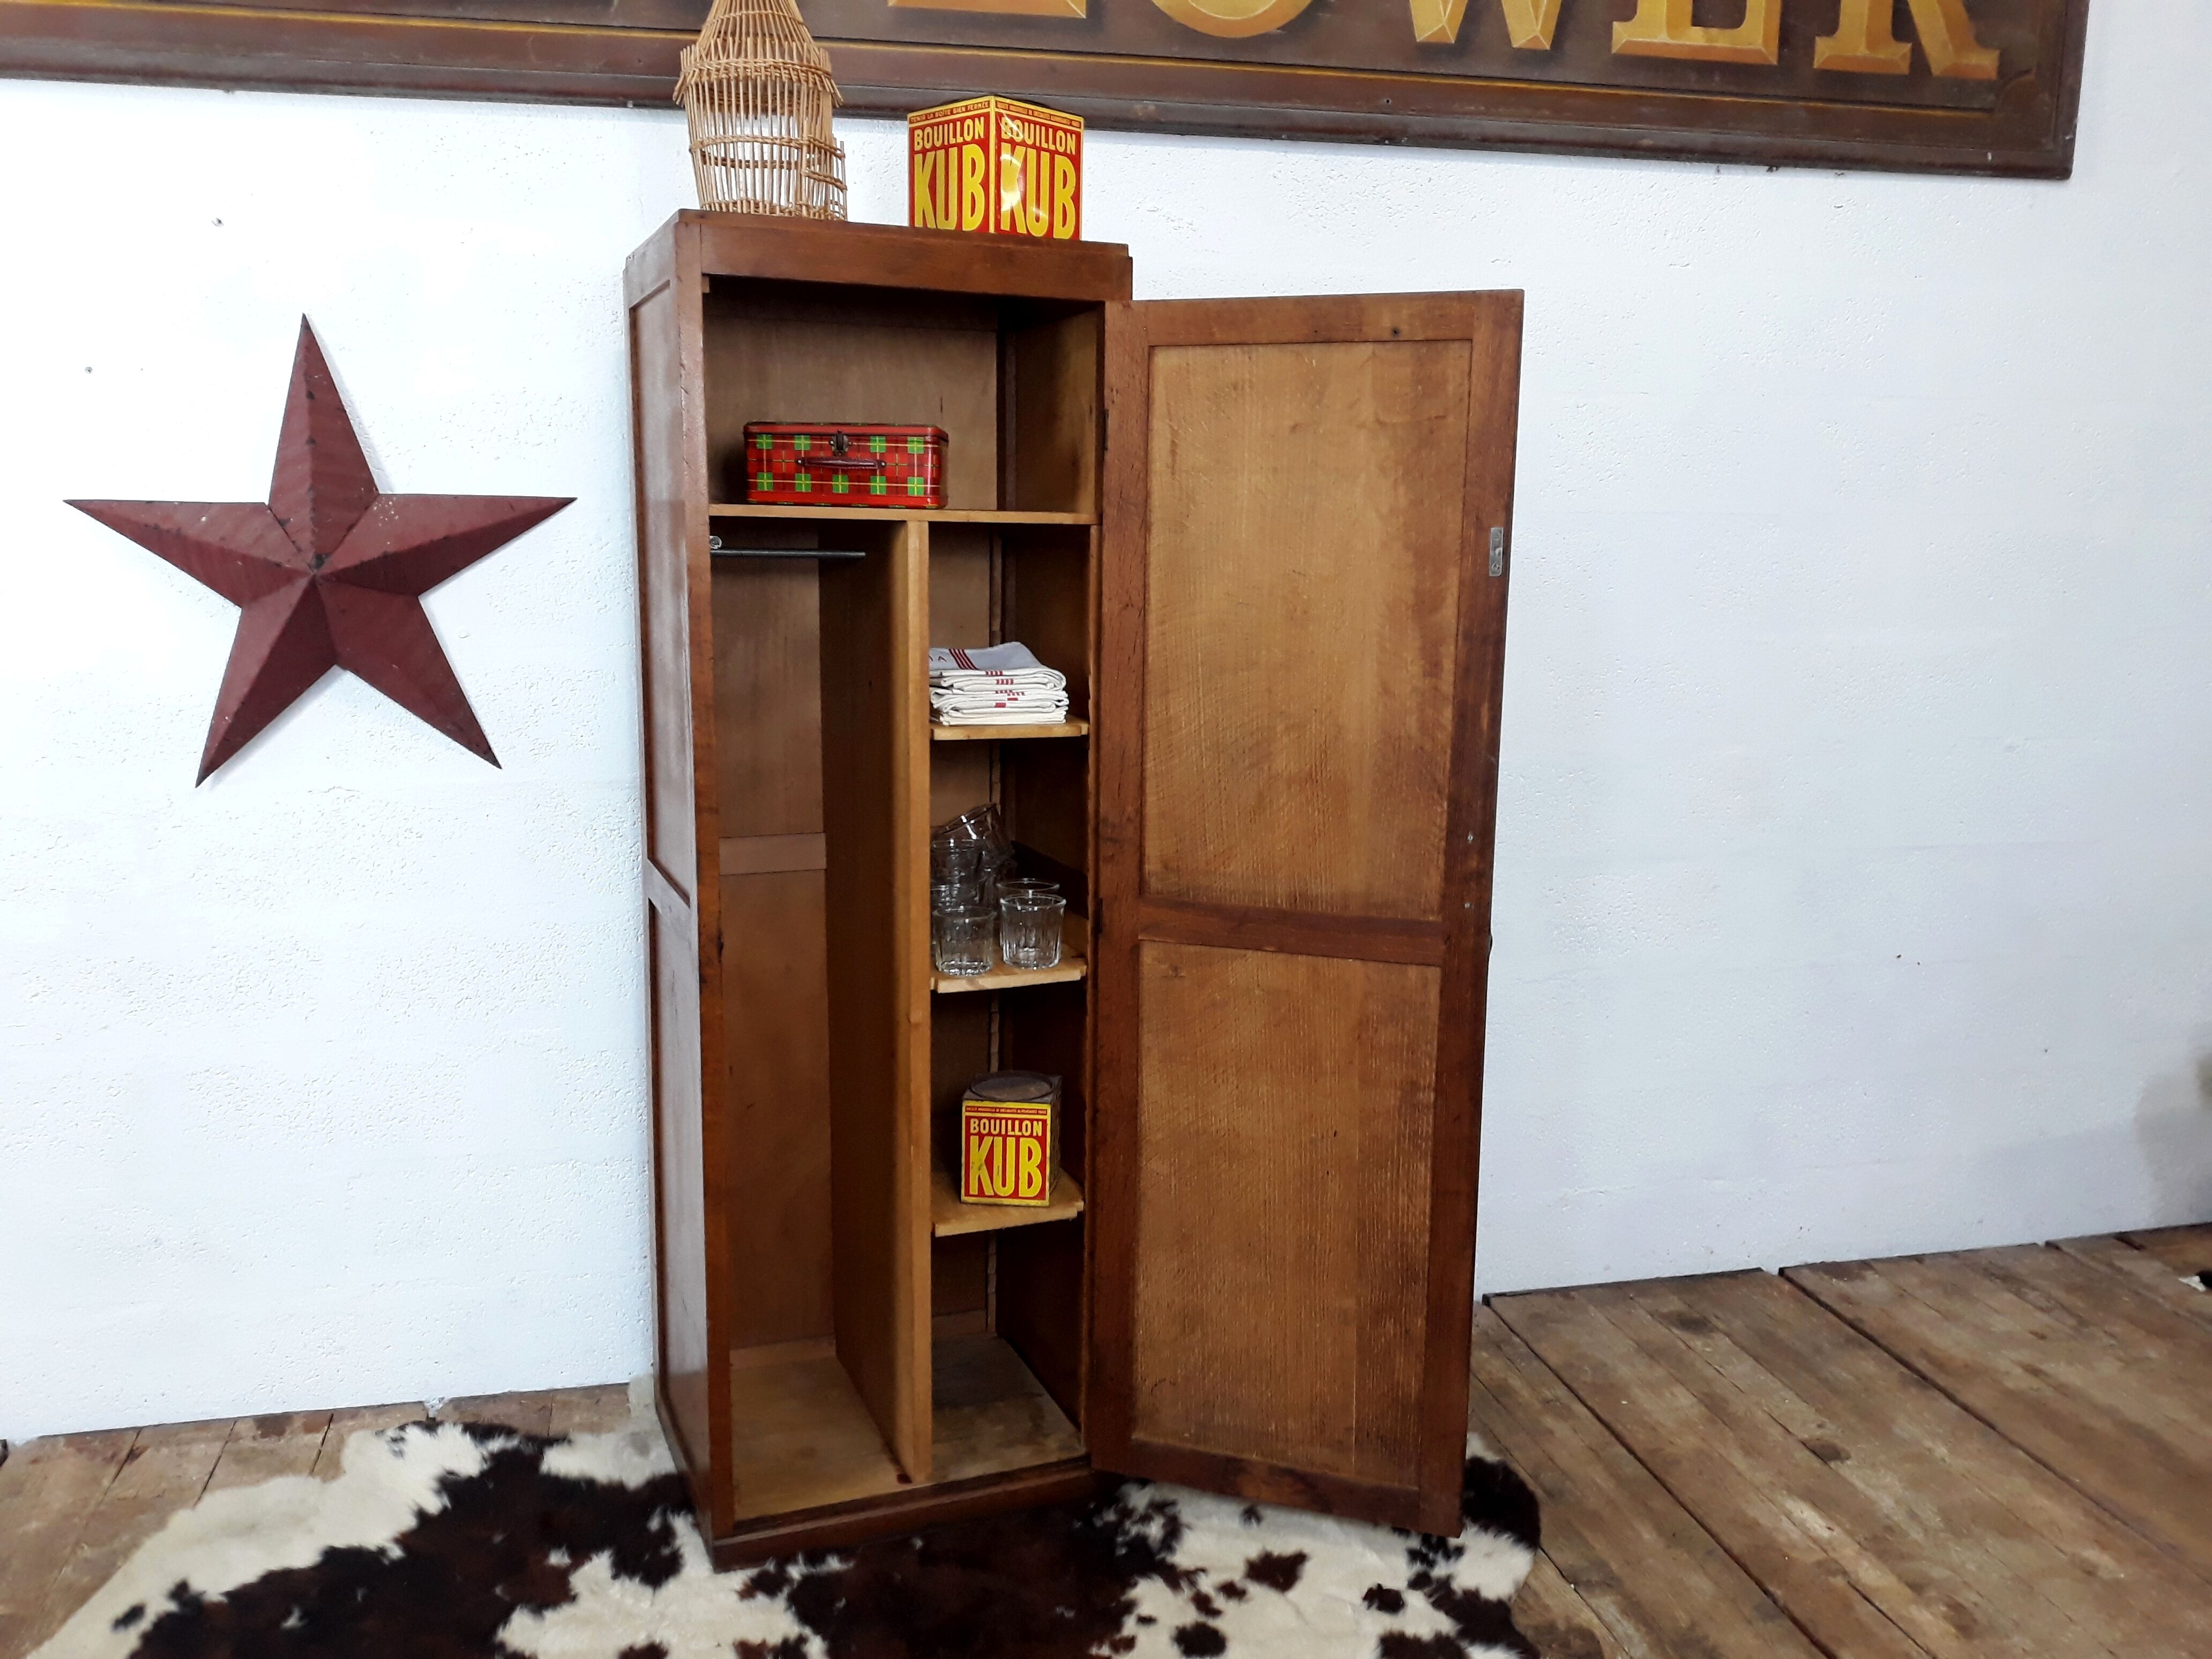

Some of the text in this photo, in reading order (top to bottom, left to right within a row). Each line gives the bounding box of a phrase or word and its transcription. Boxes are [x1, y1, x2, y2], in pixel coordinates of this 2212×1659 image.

[914, 117, 984, 151] BOUILLON
[1001, 116, 1075, 155] BOUILLON
[914, 144, 985, 231] KUB
[1000, 142, 1076, 240] KUB
[970, 1118, 1042, 1137] BOUILLON
[969, 1135, 1042, 1197] KUB
